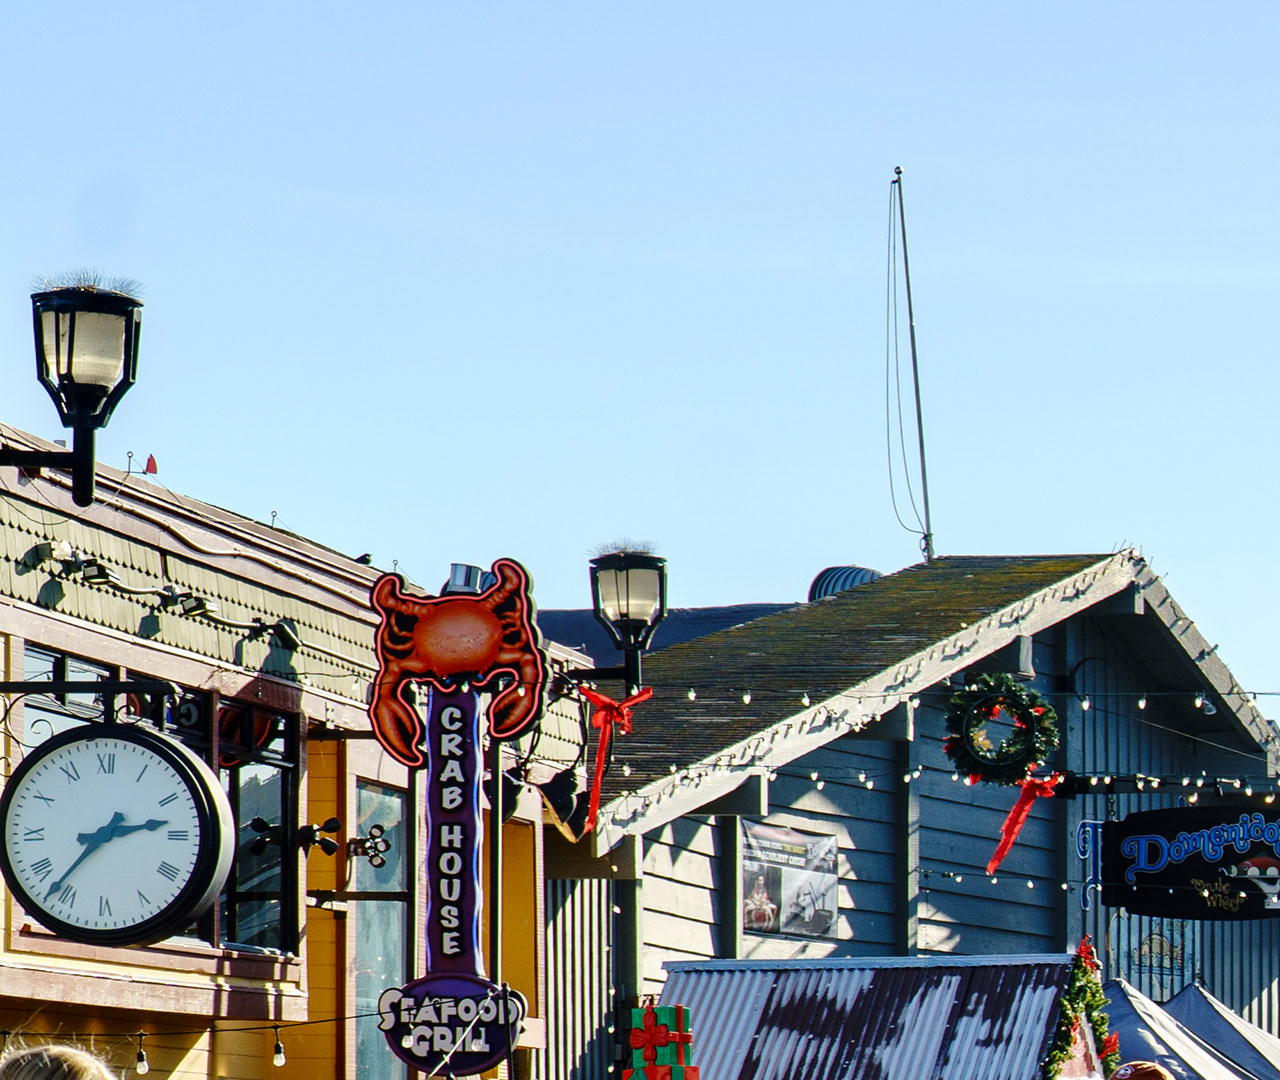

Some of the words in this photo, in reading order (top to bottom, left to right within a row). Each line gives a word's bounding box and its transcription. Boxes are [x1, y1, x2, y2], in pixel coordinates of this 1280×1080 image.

[438, 706, 464, 809] CRAB
[438, 825, 464, 955] HOUSE
[377, 988, 518, 1031] SEAFOOD
[411, 1025, 490, 1057] GRILL
